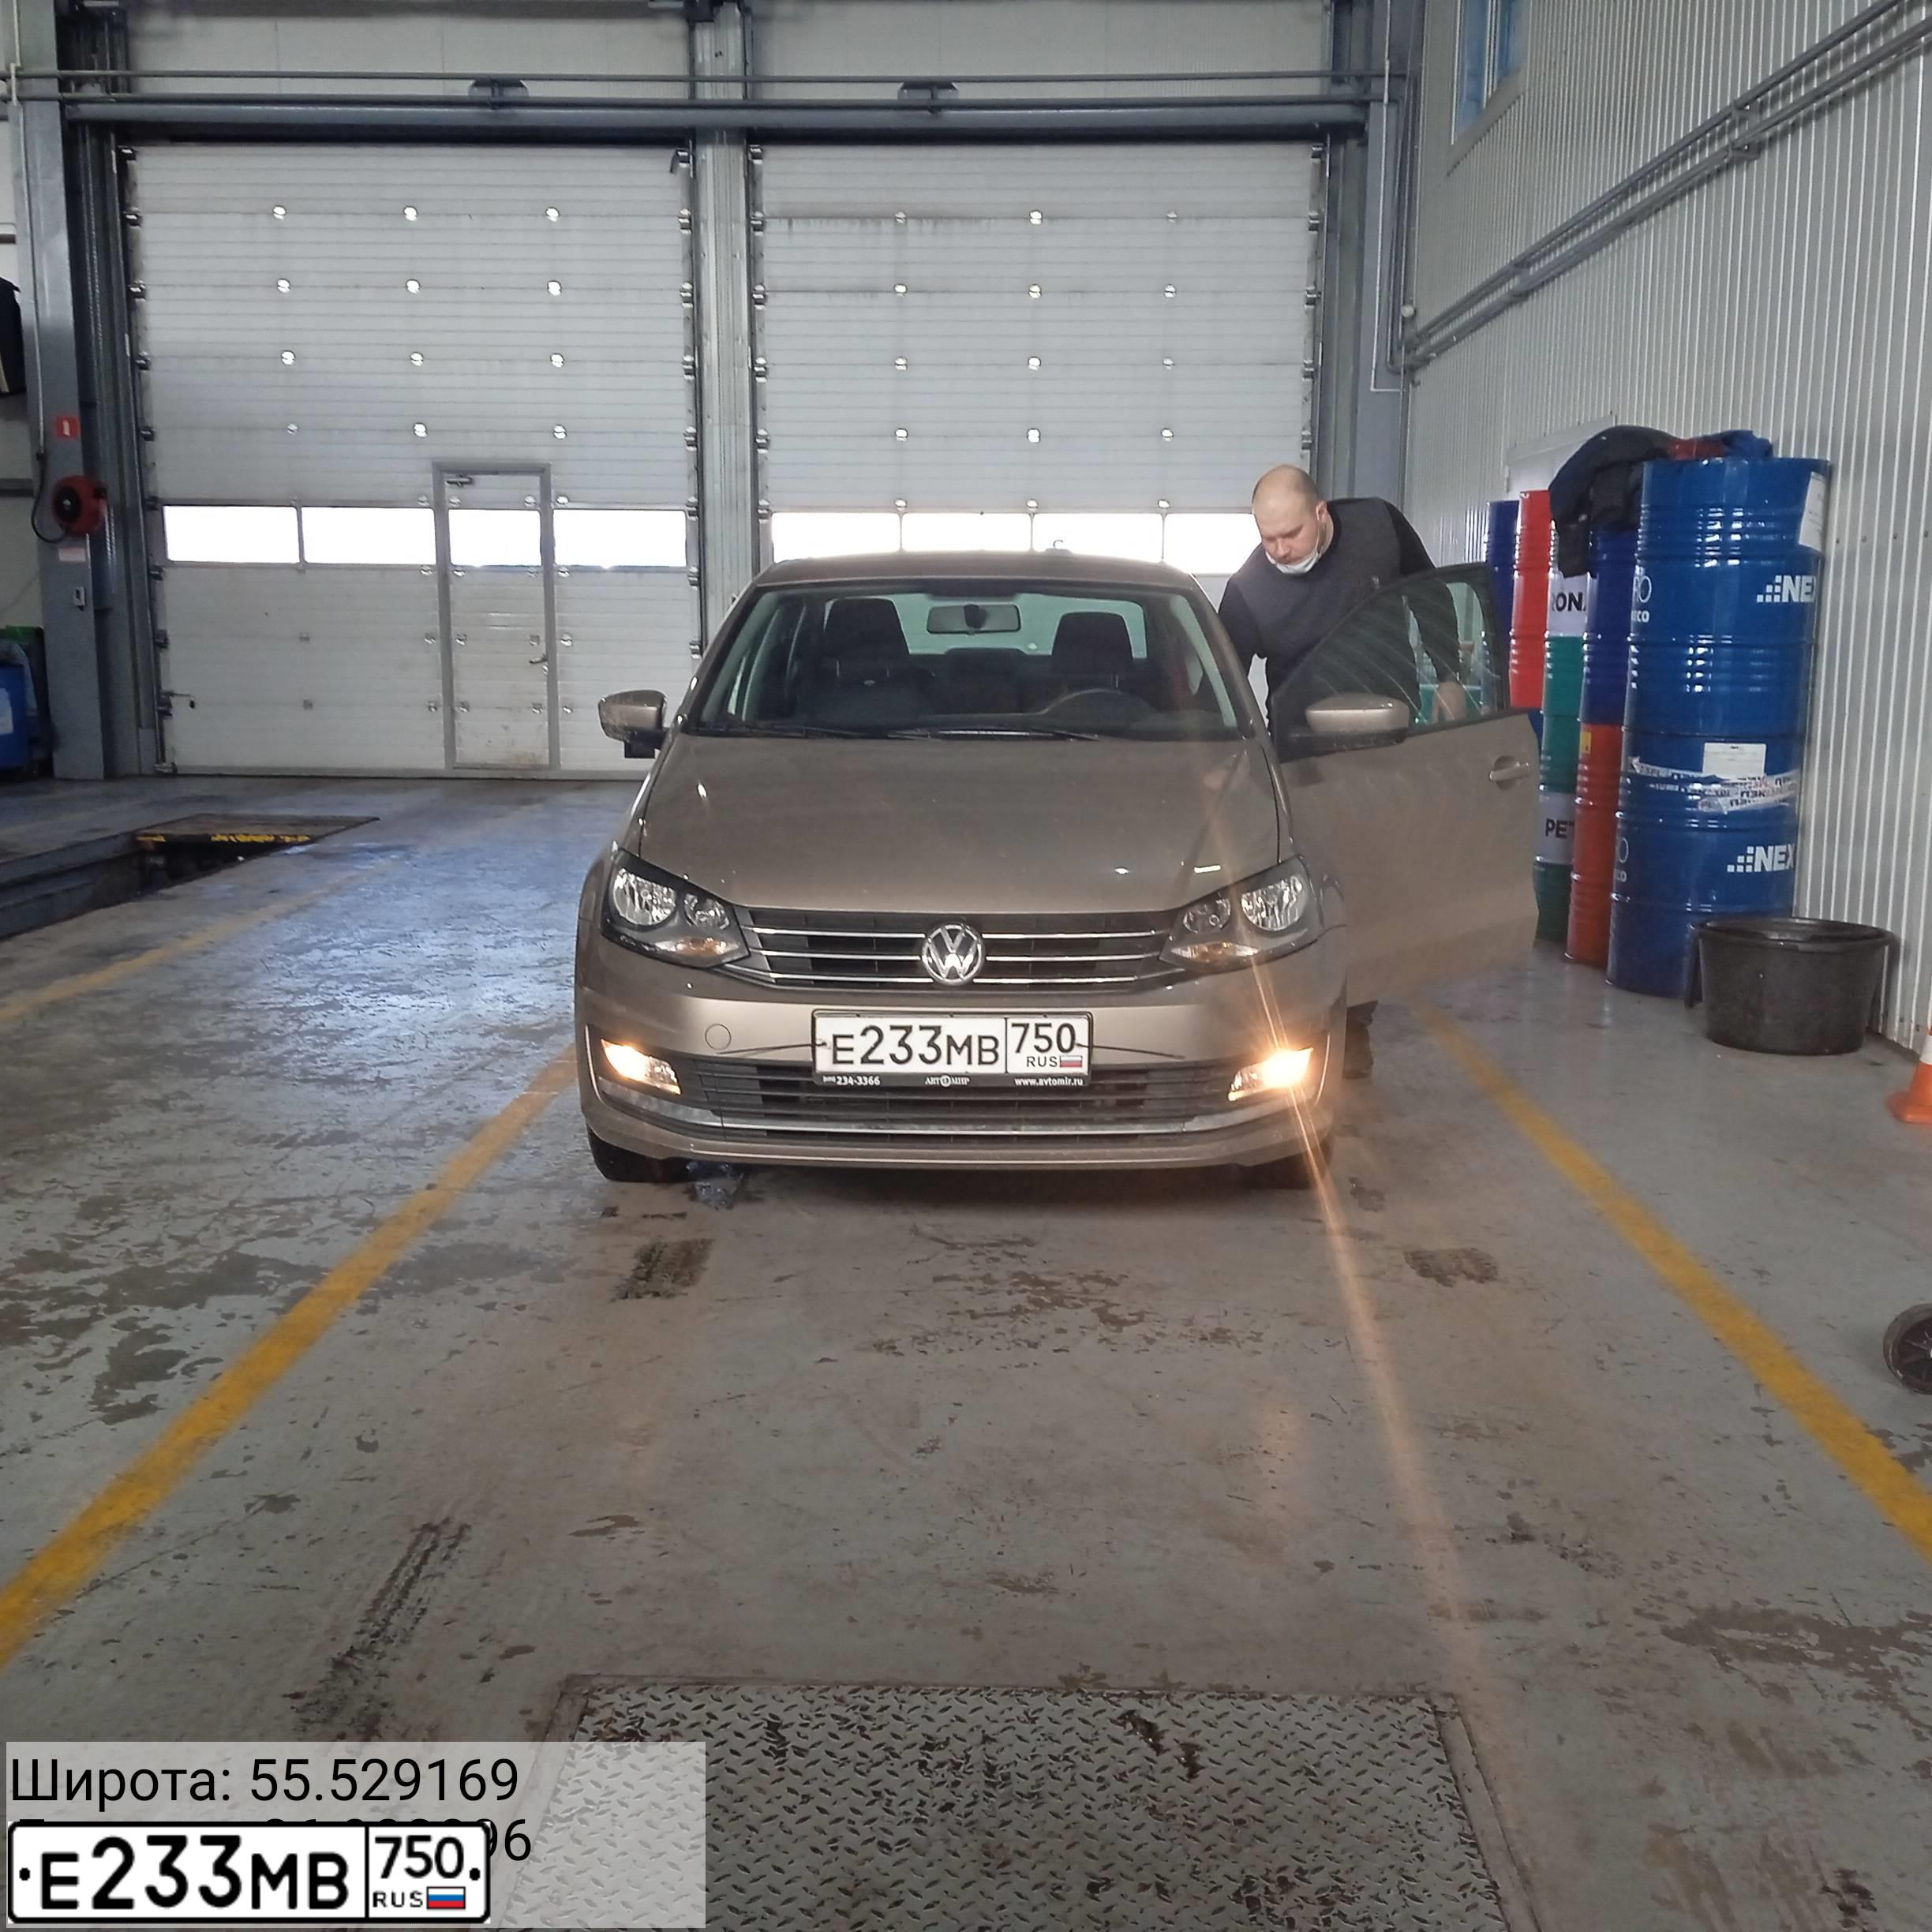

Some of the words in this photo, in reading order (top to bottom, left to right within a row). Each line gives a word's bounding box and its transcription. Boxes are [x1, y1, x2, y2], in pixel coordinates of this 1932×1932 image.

[1782, 575, 1816, 602] NE
[1552, 592, 1586, 612] ON
[1012, 1022, 1076, 1054] 750
[1026, 1055, 1058, 1068] RUS
[1014, 1076, 1084, 1087] www.avtomir.ru
